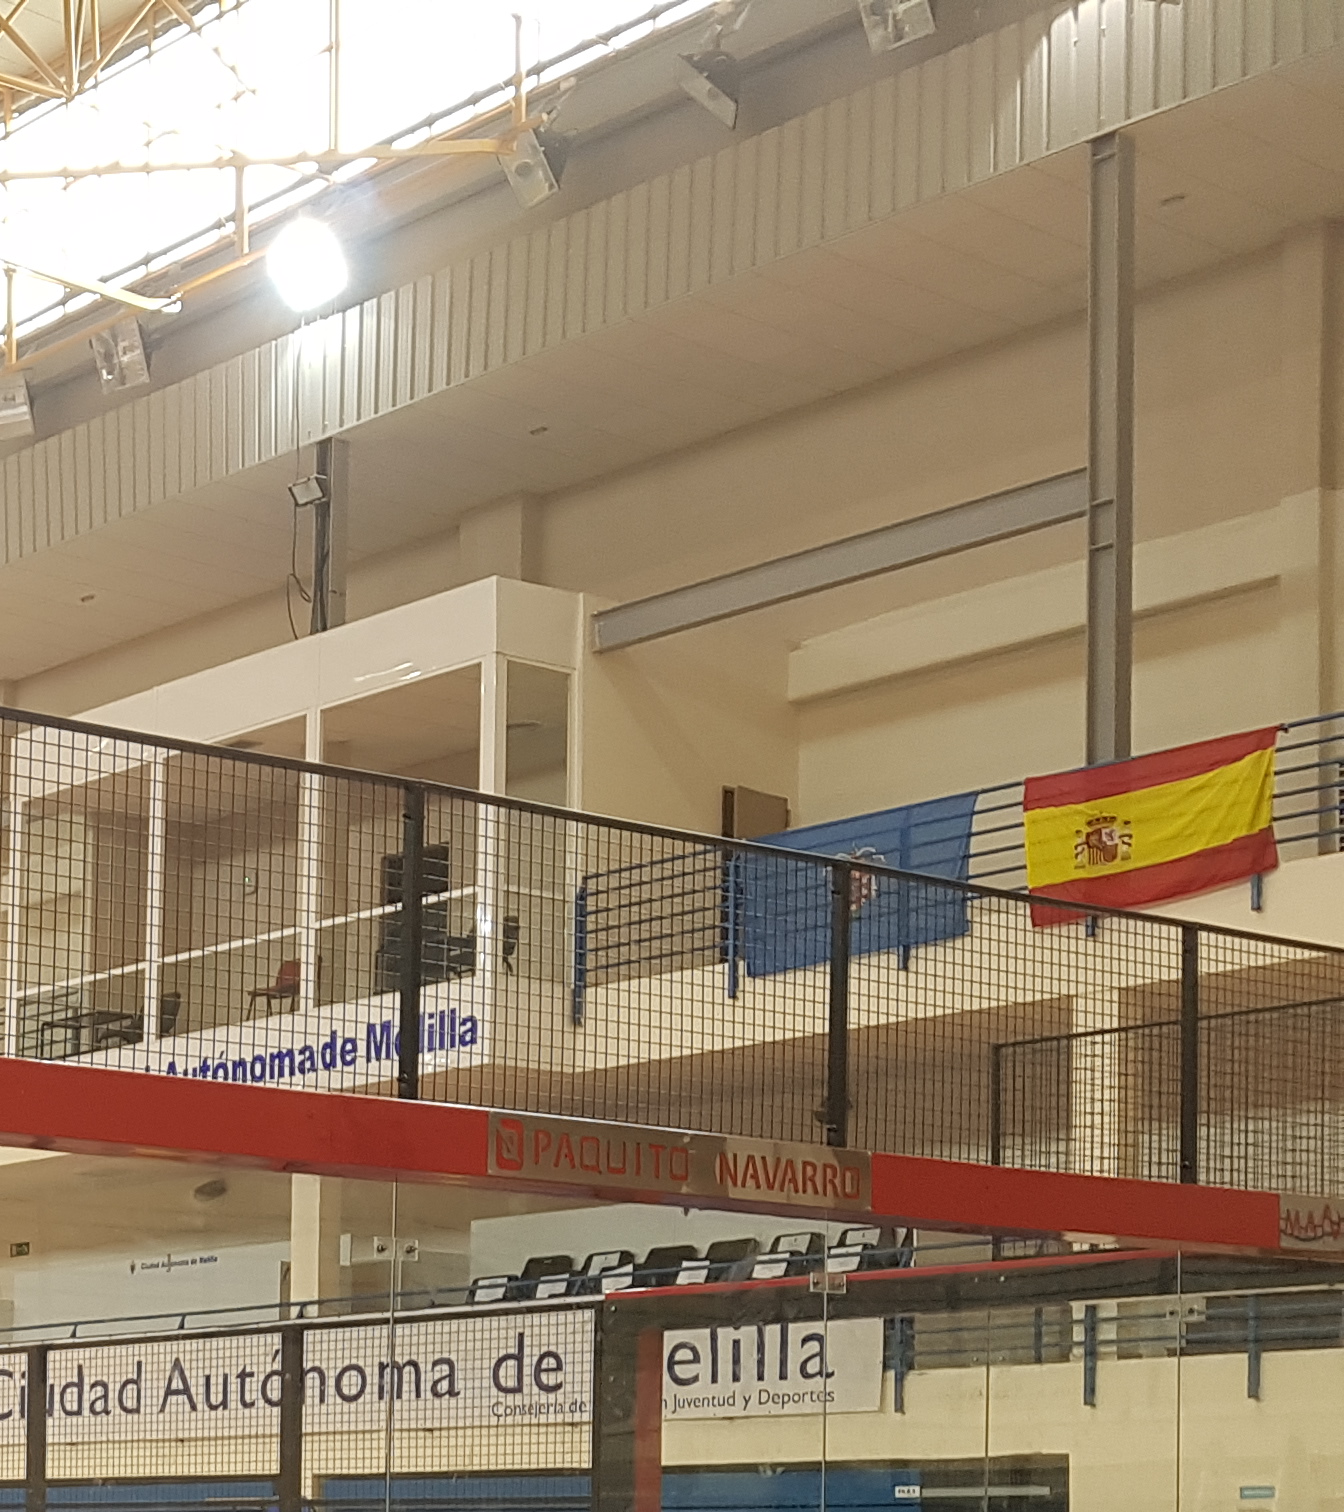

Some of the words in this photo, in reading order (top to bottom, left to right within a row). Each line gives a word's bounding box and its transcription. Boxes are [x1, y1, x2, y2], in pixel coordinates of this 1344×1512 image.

[321, 1030, 358, 1071] de
[366, 1007, 478, 1063] Mlilla
[533, 1128, 689, 1182] PAQUITO
[719, 1151, 861, 1199] NAVARRO
[158, 1349, 461, 1414] Autónoma
[491, 1332, 565, 1396] de
[666, 1323, 835, 1386] elilla
[569, 1400, 589, 1416] de
[671, 1390, 737, 1413] Juventud
[743, 1393, 752, 1412] y
[757, 1388, 836, 1410] Deportes
